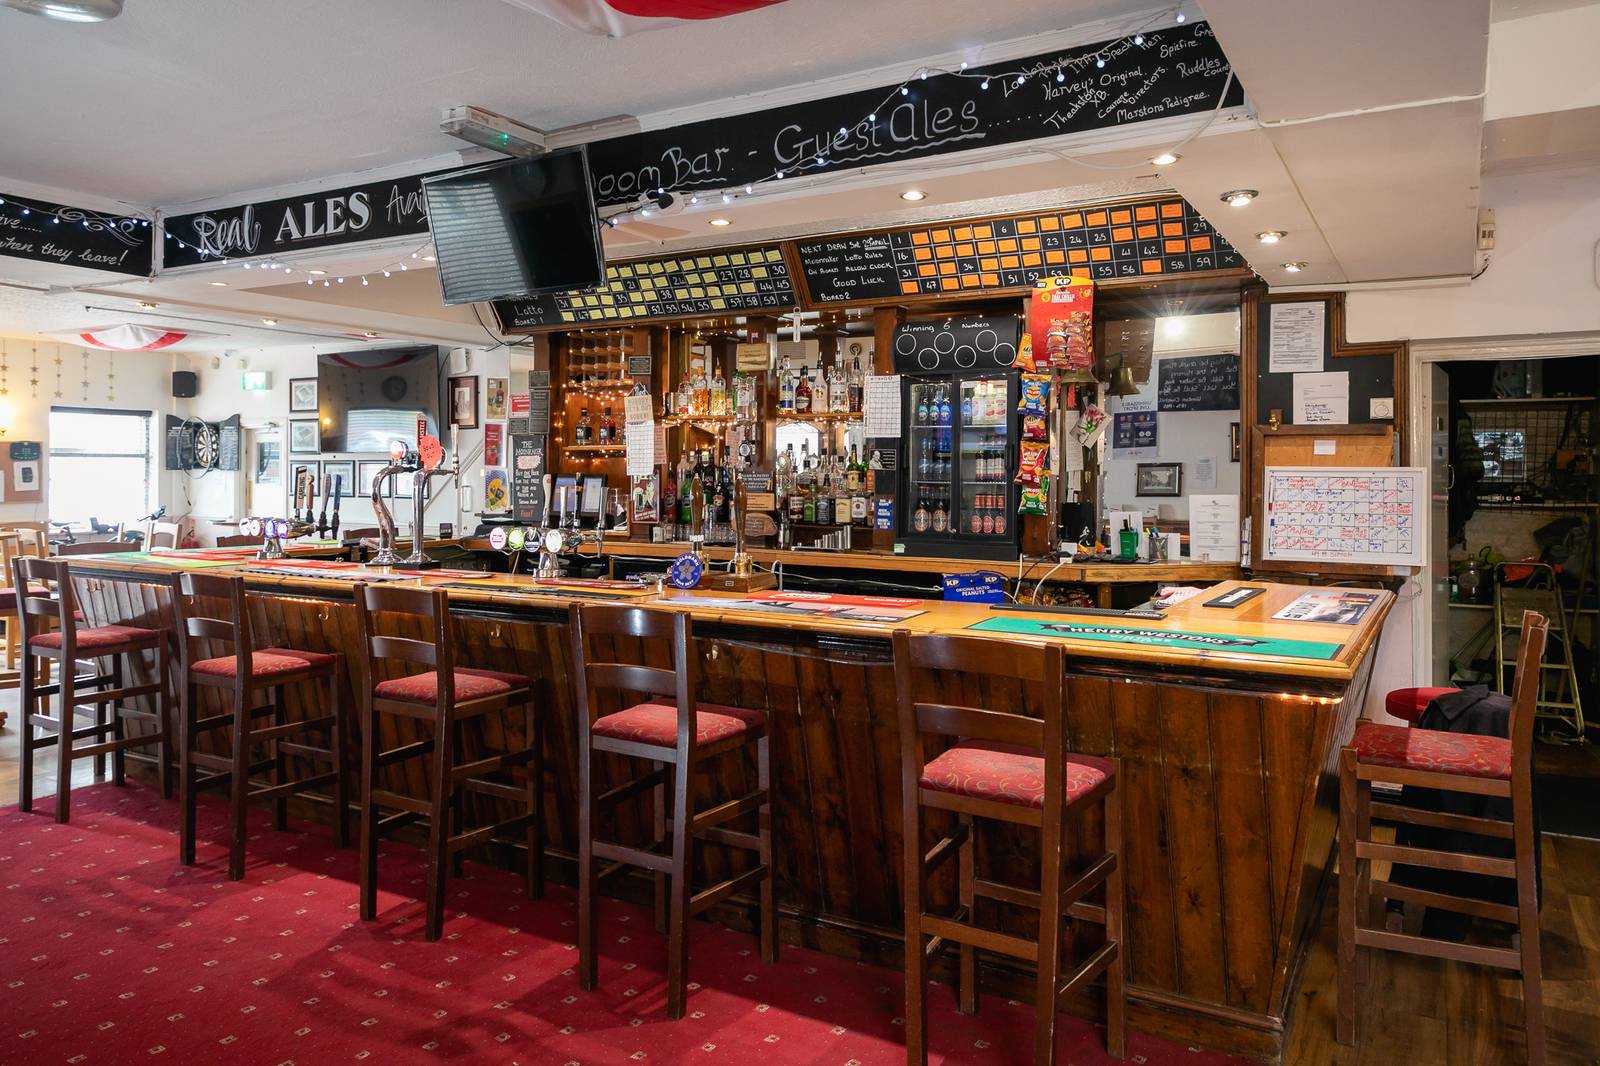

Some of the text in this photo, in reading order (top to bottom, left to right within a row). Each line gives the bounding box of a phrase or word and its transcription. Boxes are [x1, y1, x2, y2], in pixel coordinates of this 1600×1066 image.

[1176, 57, 1221, 78] Ruddles
[1116, 104, 1165, 123] Marstons
[772, 112, 882, 165] Guest
[890, 98, 980, 144] Ales
[589, 165, 661, 197] oom
[192, 204, 262, 261] Real
[273, 191, 373, 244] ALES
[41, 241, 73, 262] they
[78, 248, 129, 267] leave!
[943, 321, 951, 330] 6
[946, 579, 960, 587] KP
[1069, 626, 1230, 645] HENRY WESTONS
